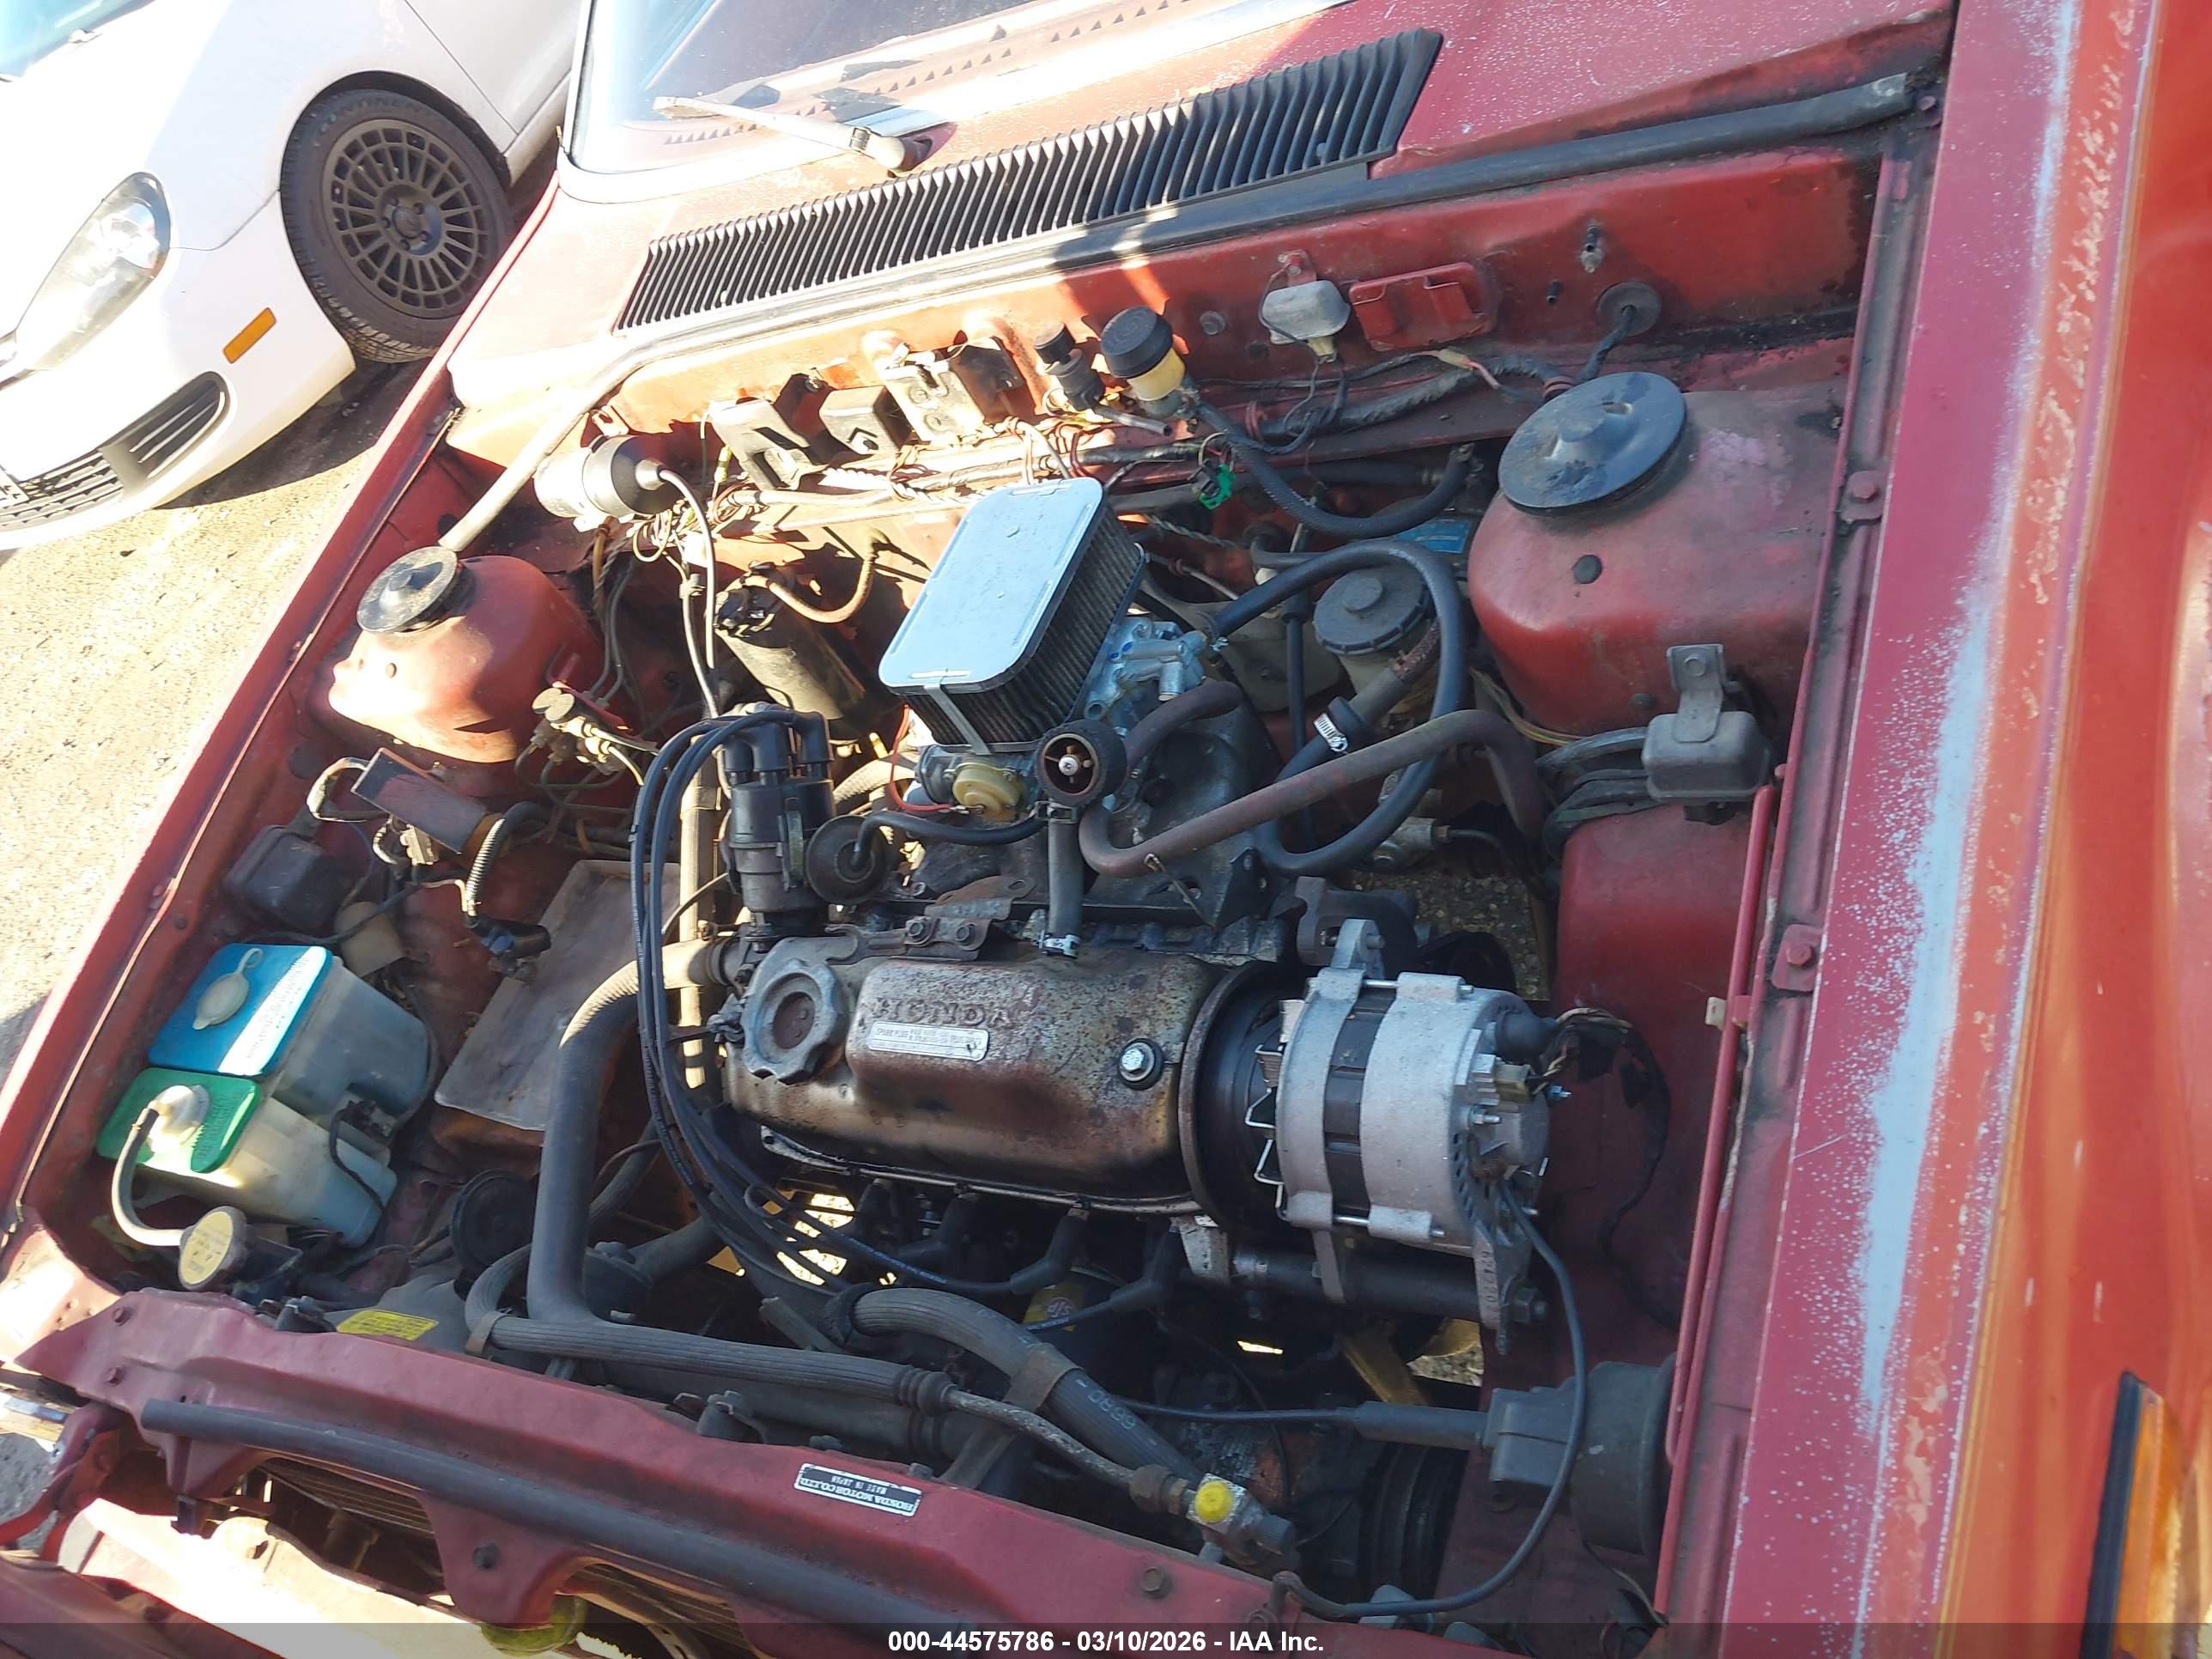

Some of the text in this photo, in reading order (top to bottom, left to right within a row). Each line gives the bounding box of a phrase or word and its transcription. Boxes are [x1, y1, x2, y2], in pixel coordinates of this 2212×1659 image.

[872, 996, 1013, 1028] HONDA
[836, 1487, 872, 1502] MOTOR
[873, 1495, 914, 1511] HONDA
